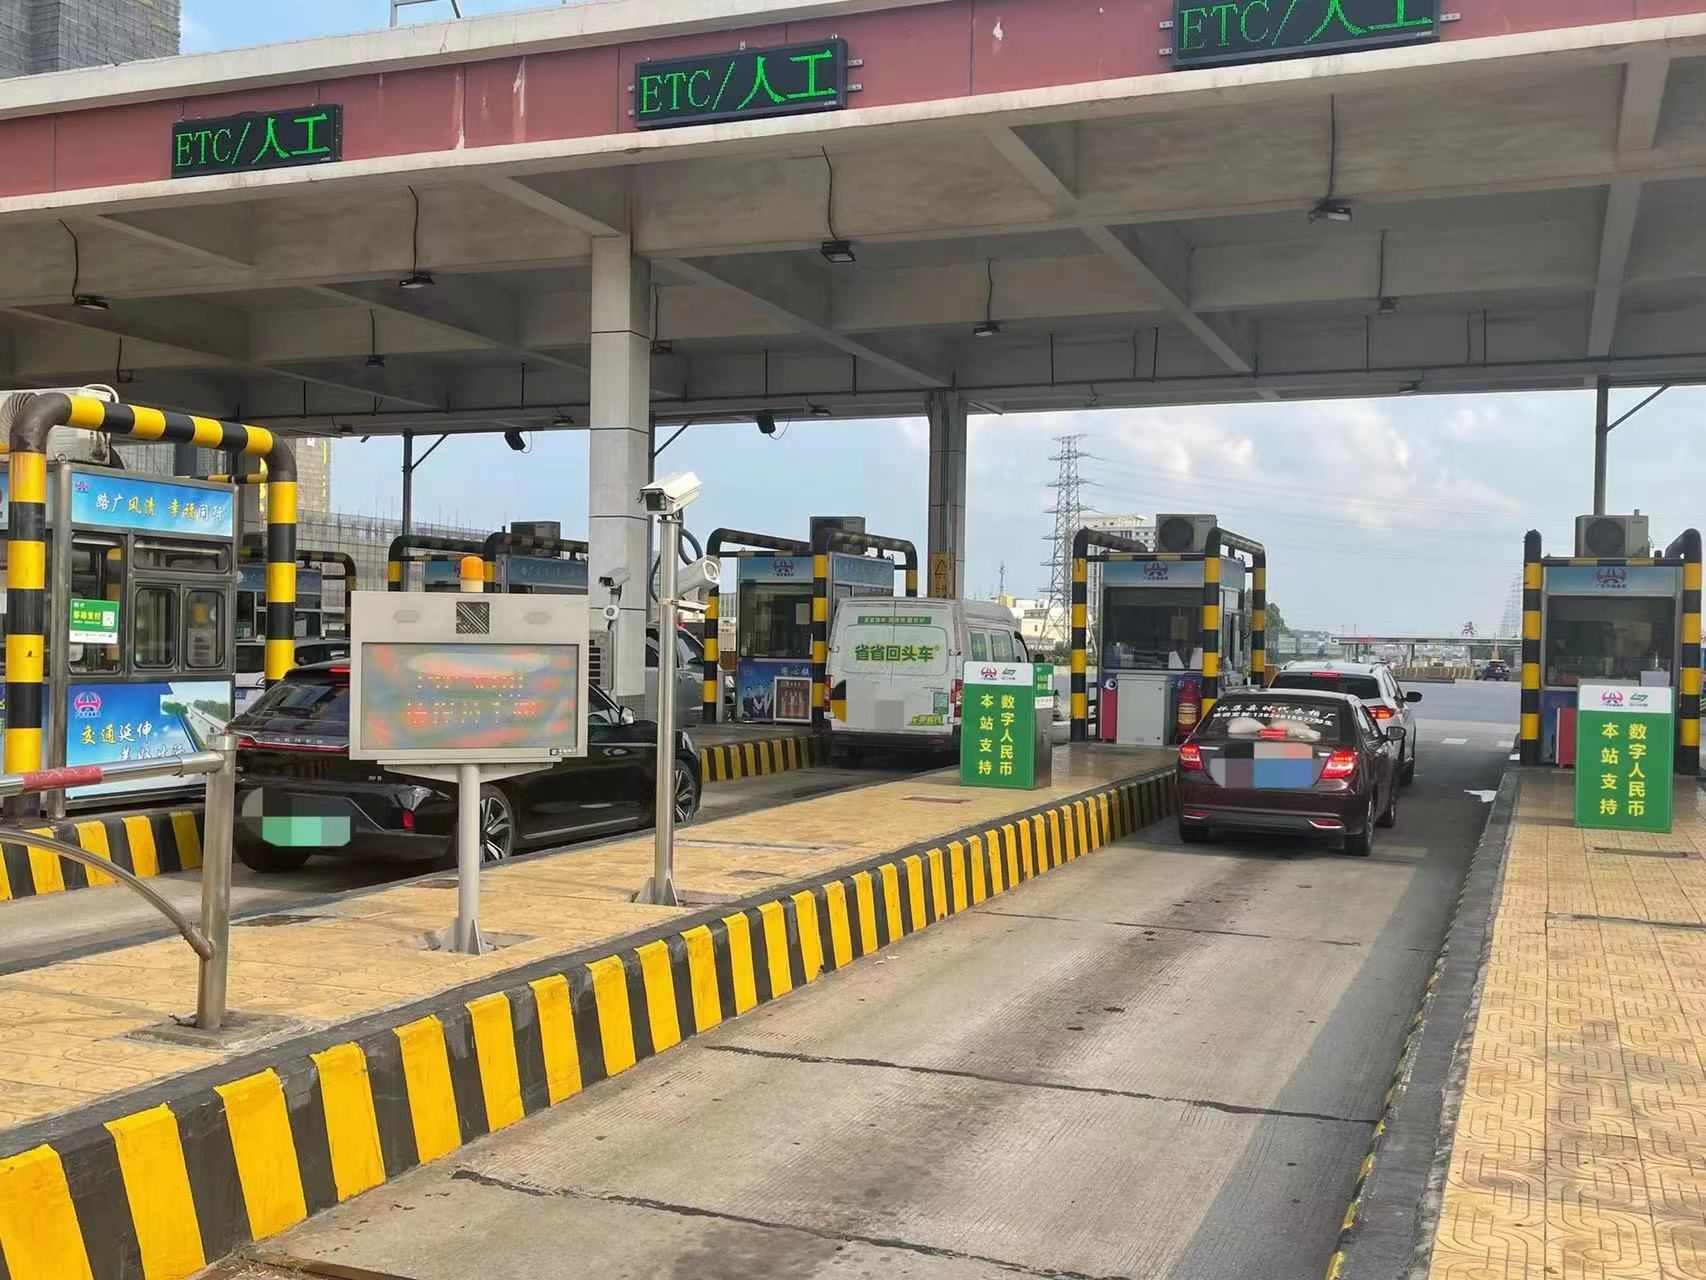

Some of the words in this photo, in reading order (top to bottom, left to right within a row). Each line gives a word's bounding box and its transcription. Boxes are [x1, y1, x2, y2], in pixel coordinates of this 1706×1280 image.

[640, 49, 837, 113] ETC/人工
[176, 112, 331, 167] ETC/人工
[167, 498, 226, 522] 幸福同行
[855, 643, 934, 662] 省省回头车
[81, 721, 153, 746] 交通延伸
[978, 693, 994, 775] 本站支持
[1000, 694, 1015, 776] 数字人民币
[1600, 721, 1619, 816] 本站支持
[1628, 723, 1648, 817] 数字人民币
